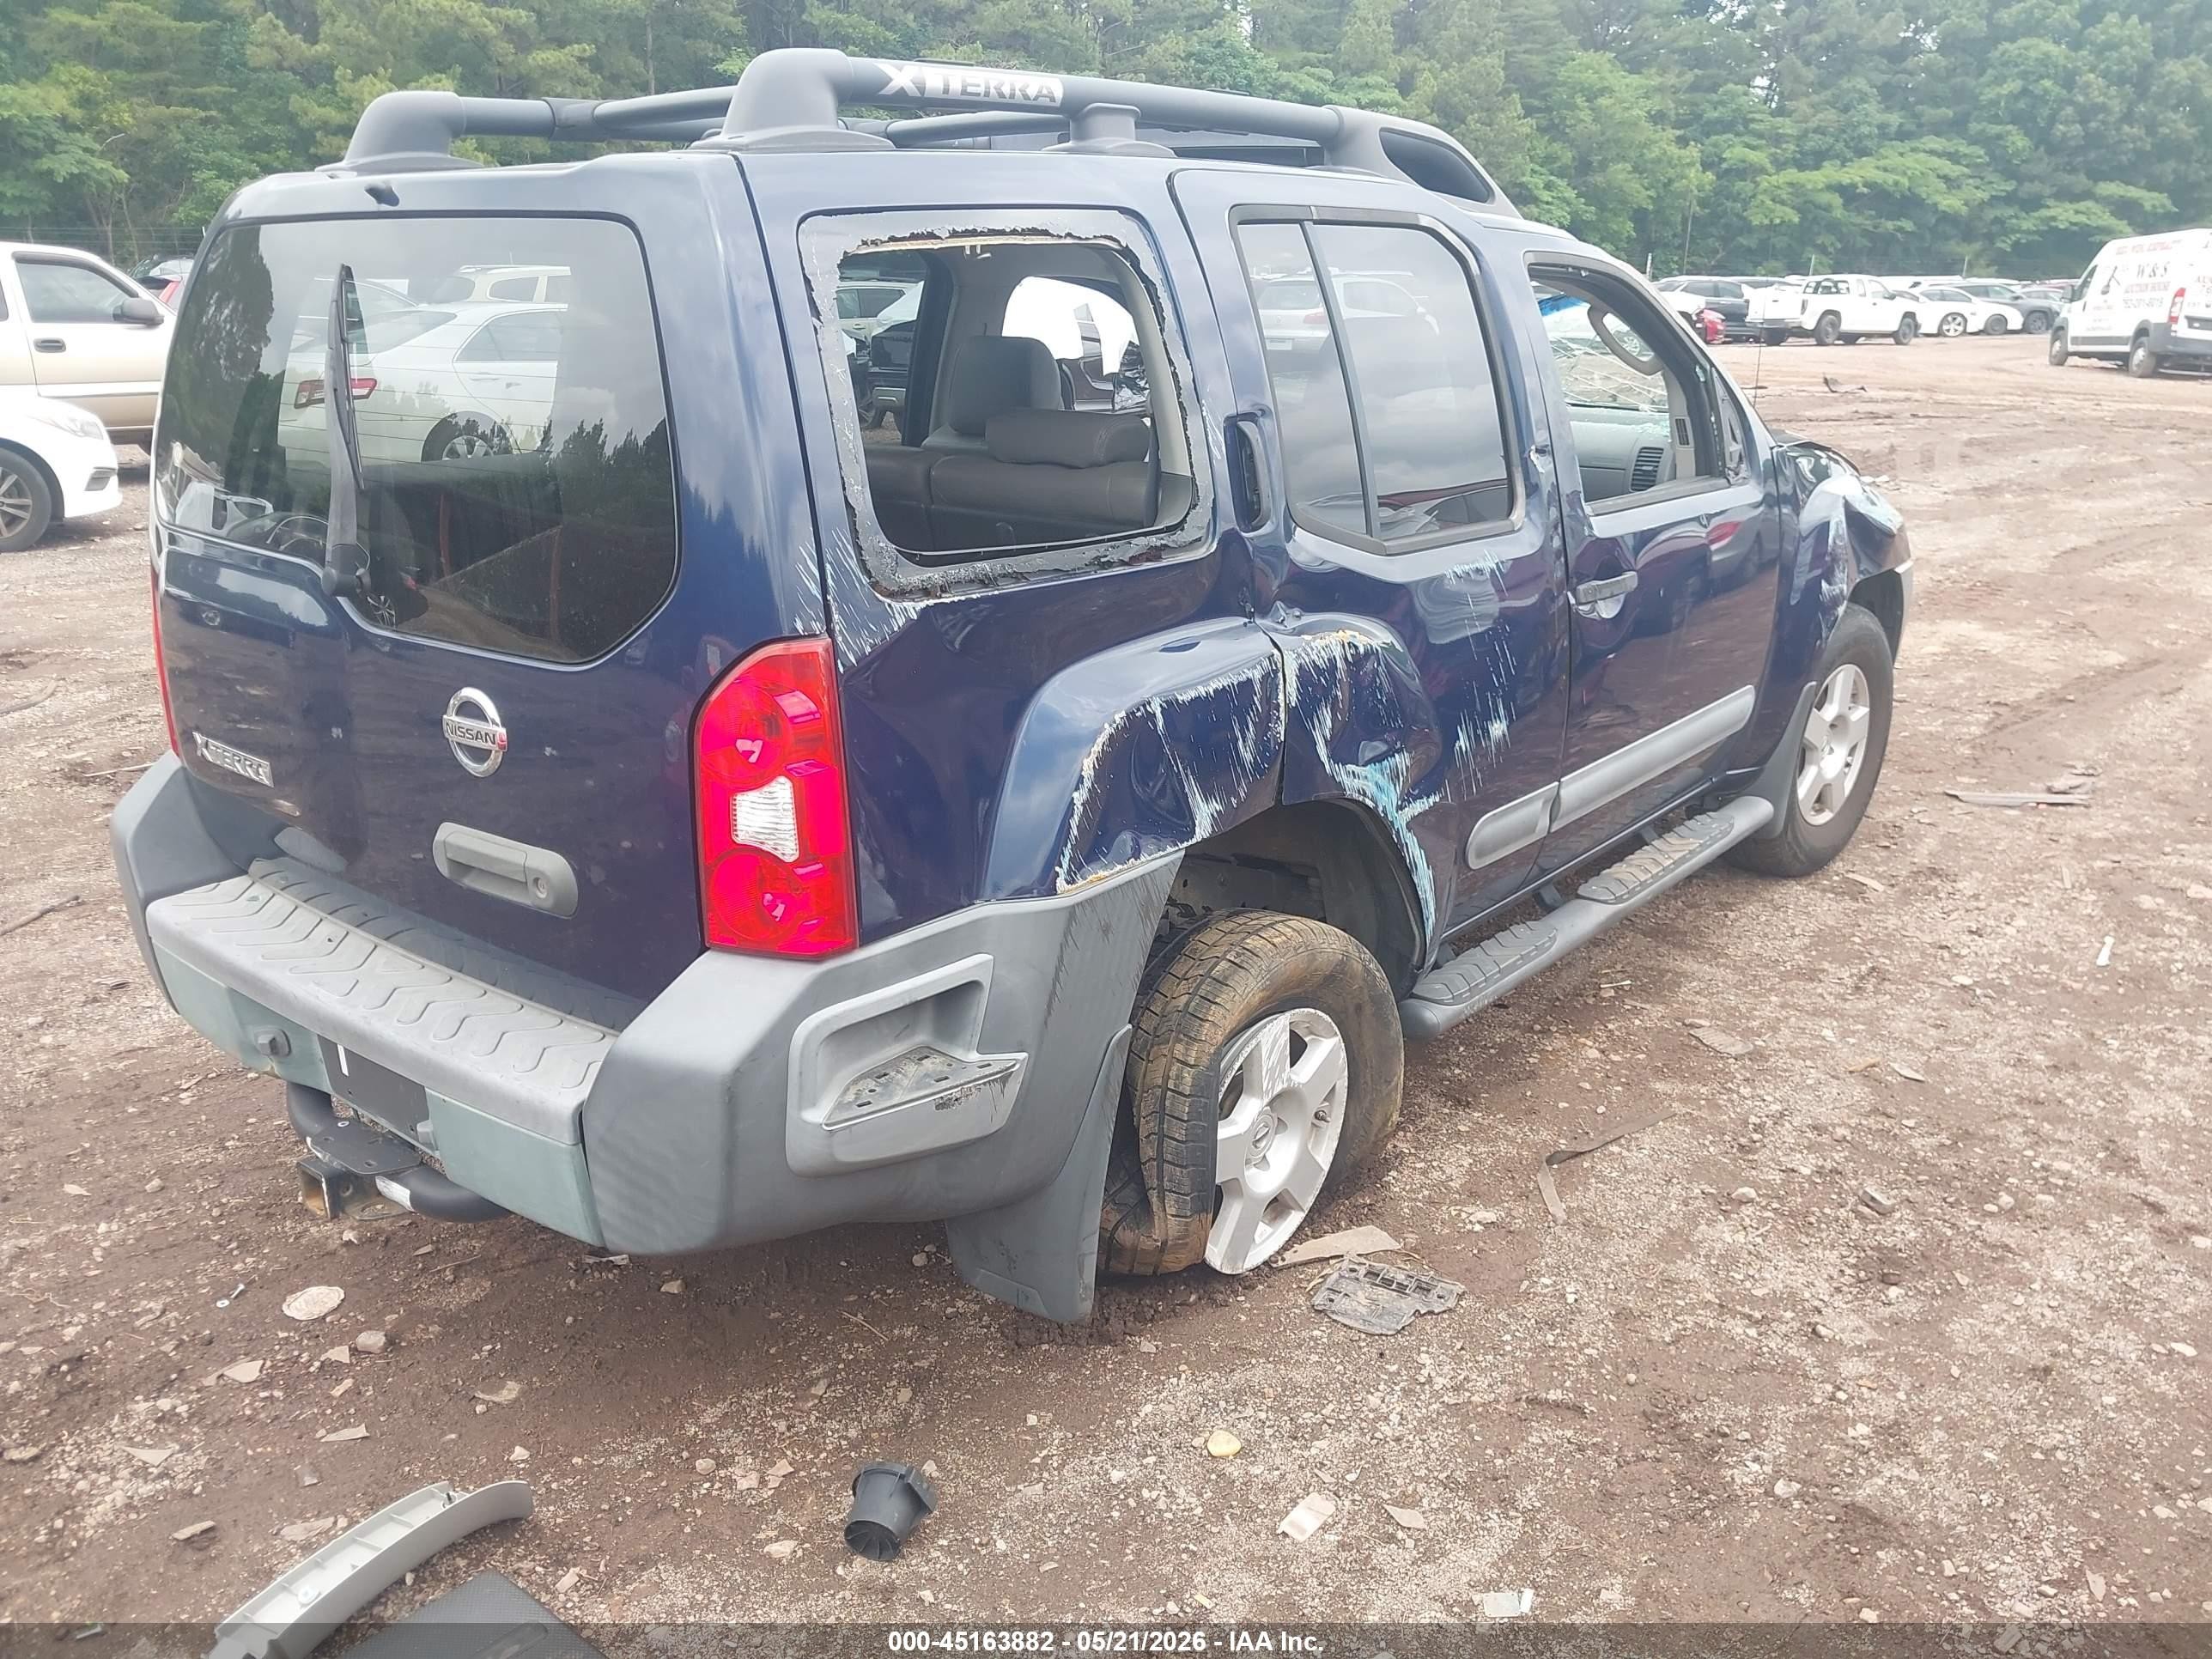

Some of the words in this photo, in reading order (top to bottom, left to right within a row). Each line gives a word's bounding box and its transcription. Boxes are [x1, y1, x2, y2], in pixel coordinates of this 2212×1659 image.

[873, 63, 1063, 106] XTERRA
[446, 721, 496, 745] NISSAN
[191, 732, 275, 787] XTERRA
